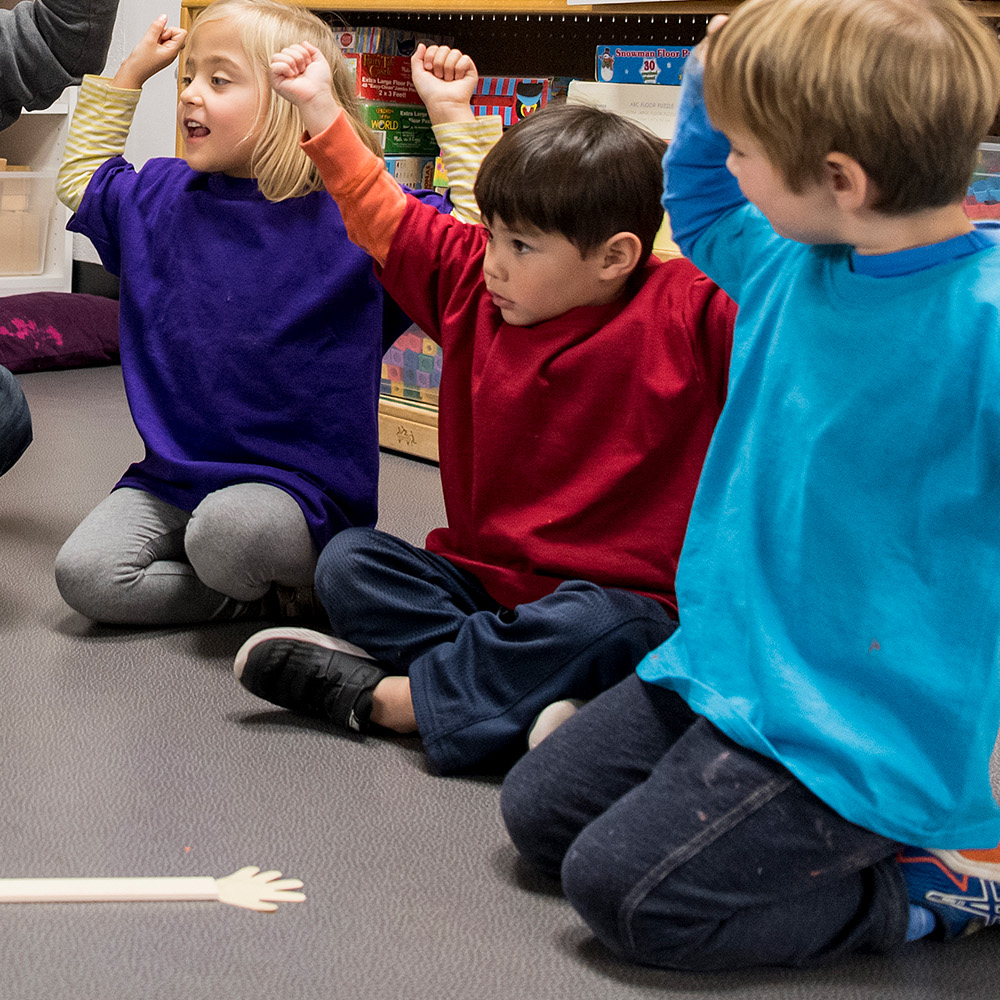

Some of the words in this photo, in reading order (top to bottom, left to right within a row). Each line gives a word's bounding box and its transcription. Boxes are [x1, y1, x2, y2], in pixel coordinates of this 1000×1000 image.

[615, 48, 655, 57] Snowman
[657, 49, 680, 57] Floor
[644, 60, 655, 71] 30
[377, 78, 392, 86] Large
[371, 120, 399, 130] WORLD
